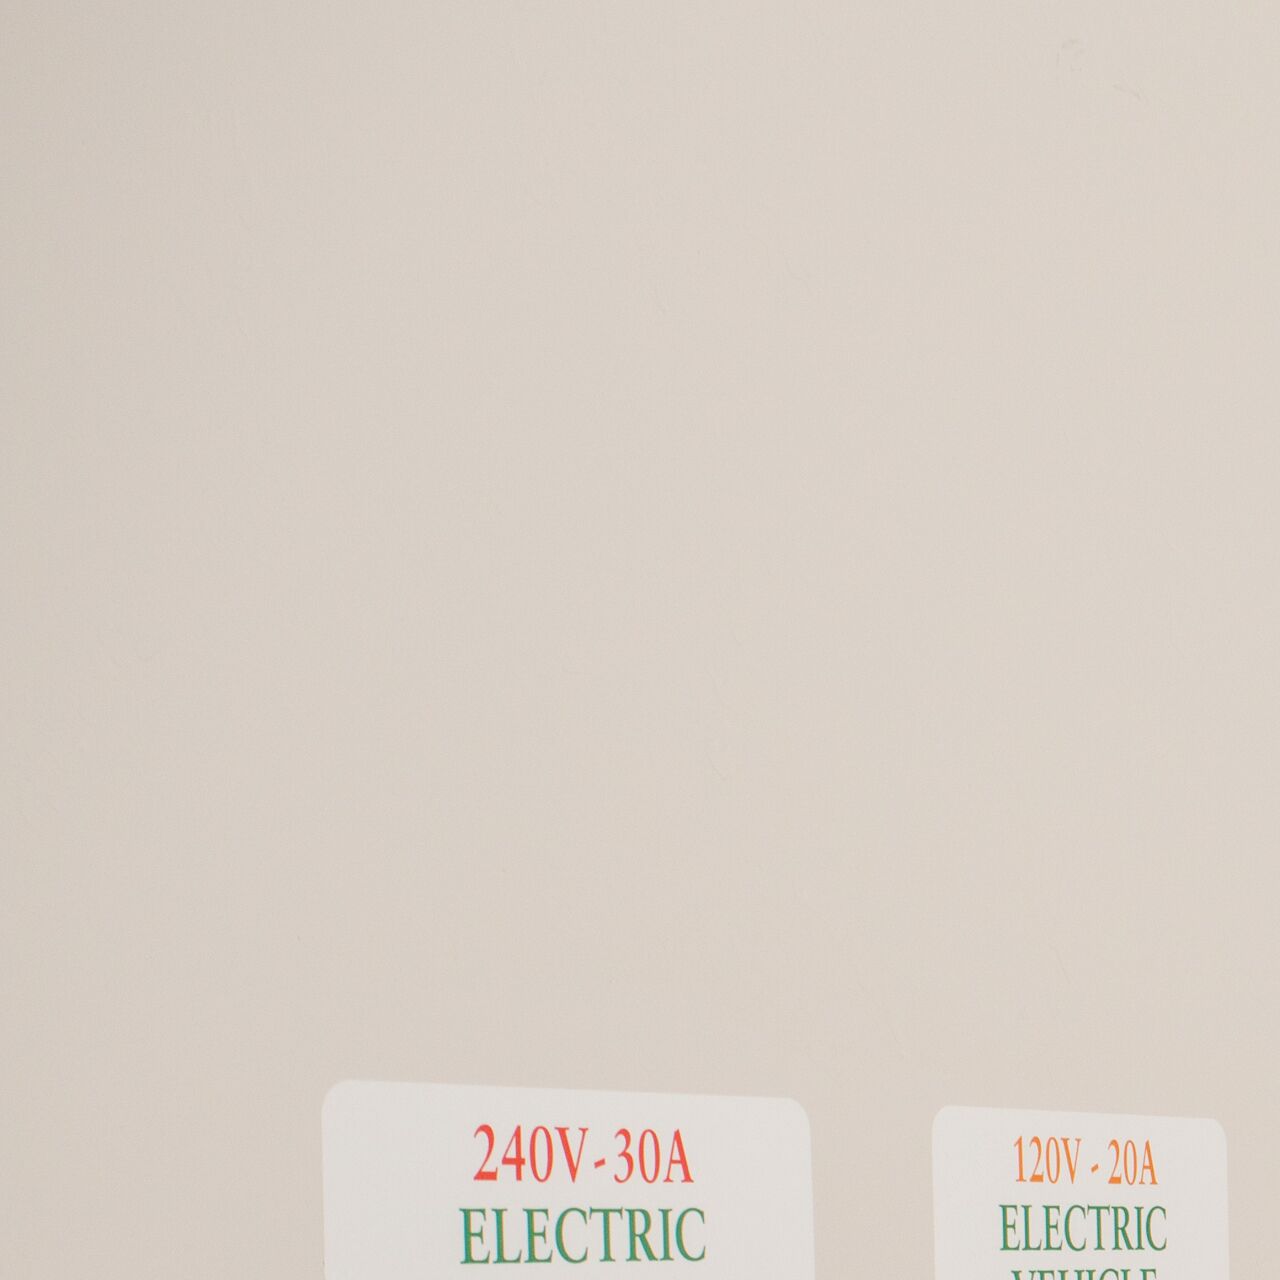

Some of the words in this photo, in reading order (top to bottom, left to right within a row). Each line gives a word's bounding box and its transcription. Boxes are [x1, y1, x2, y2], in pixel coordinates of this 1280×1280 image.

[1014, 1135, 1082, 1186] 120V
[1107, 1139, 1159, 1187] 20A
[459, 1207, 707, 1265] ELECTRIC
[999, 1204, 1168, 1252] ELECTRIC
